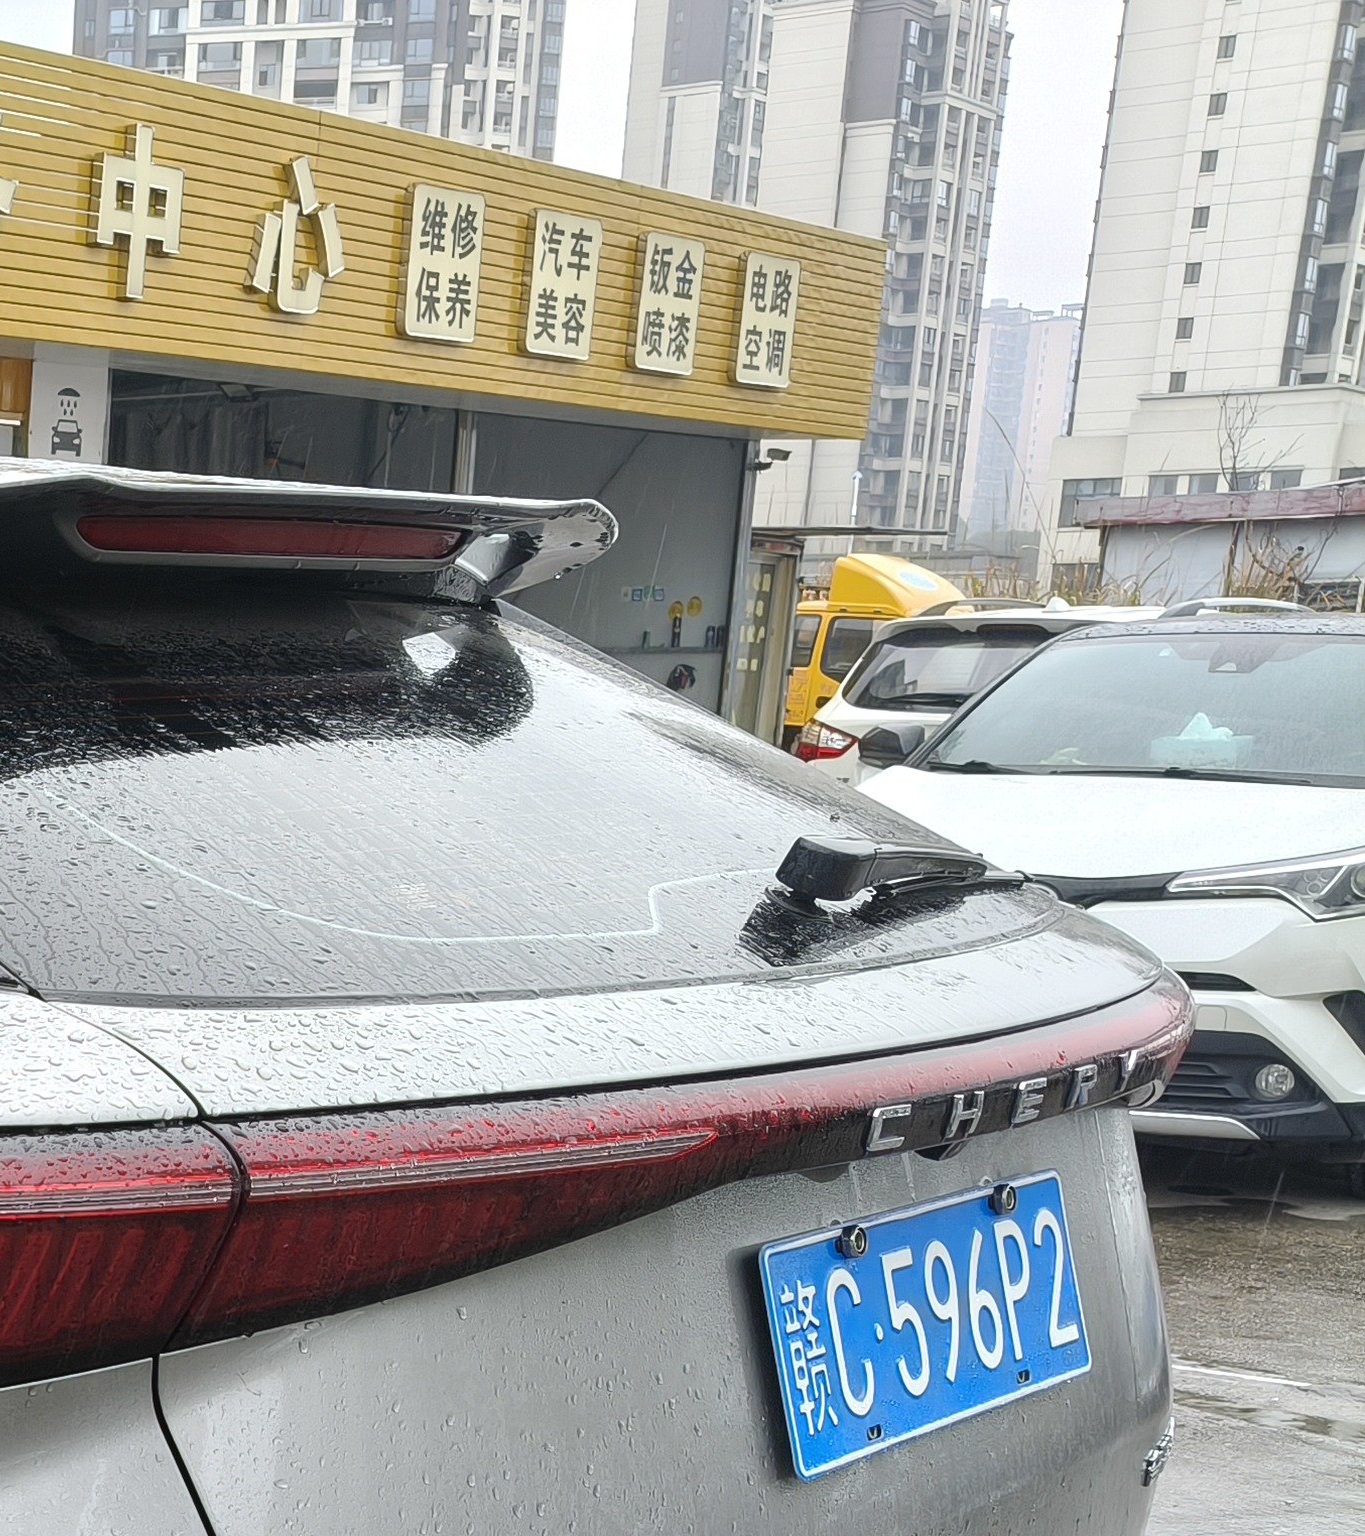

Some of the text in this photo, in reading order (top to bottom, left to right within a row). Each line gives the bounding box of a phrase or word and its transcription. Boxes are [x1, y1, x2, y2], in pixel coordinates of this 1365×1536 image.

[418, 197, 479, 260] 维修
[540, 220, 594, 281] 汽车
[414, 267, 472, 329] 保养
[649, 242, 699, 302] 钣金
[749, 264, 793, 317] 电路
[533, 288, 586, 347] 美容
[641, 309, 692, 364] 喷漆
[742, 324, 787, 376] 空调
[867, 1050, 1138, 1152] CHERY
